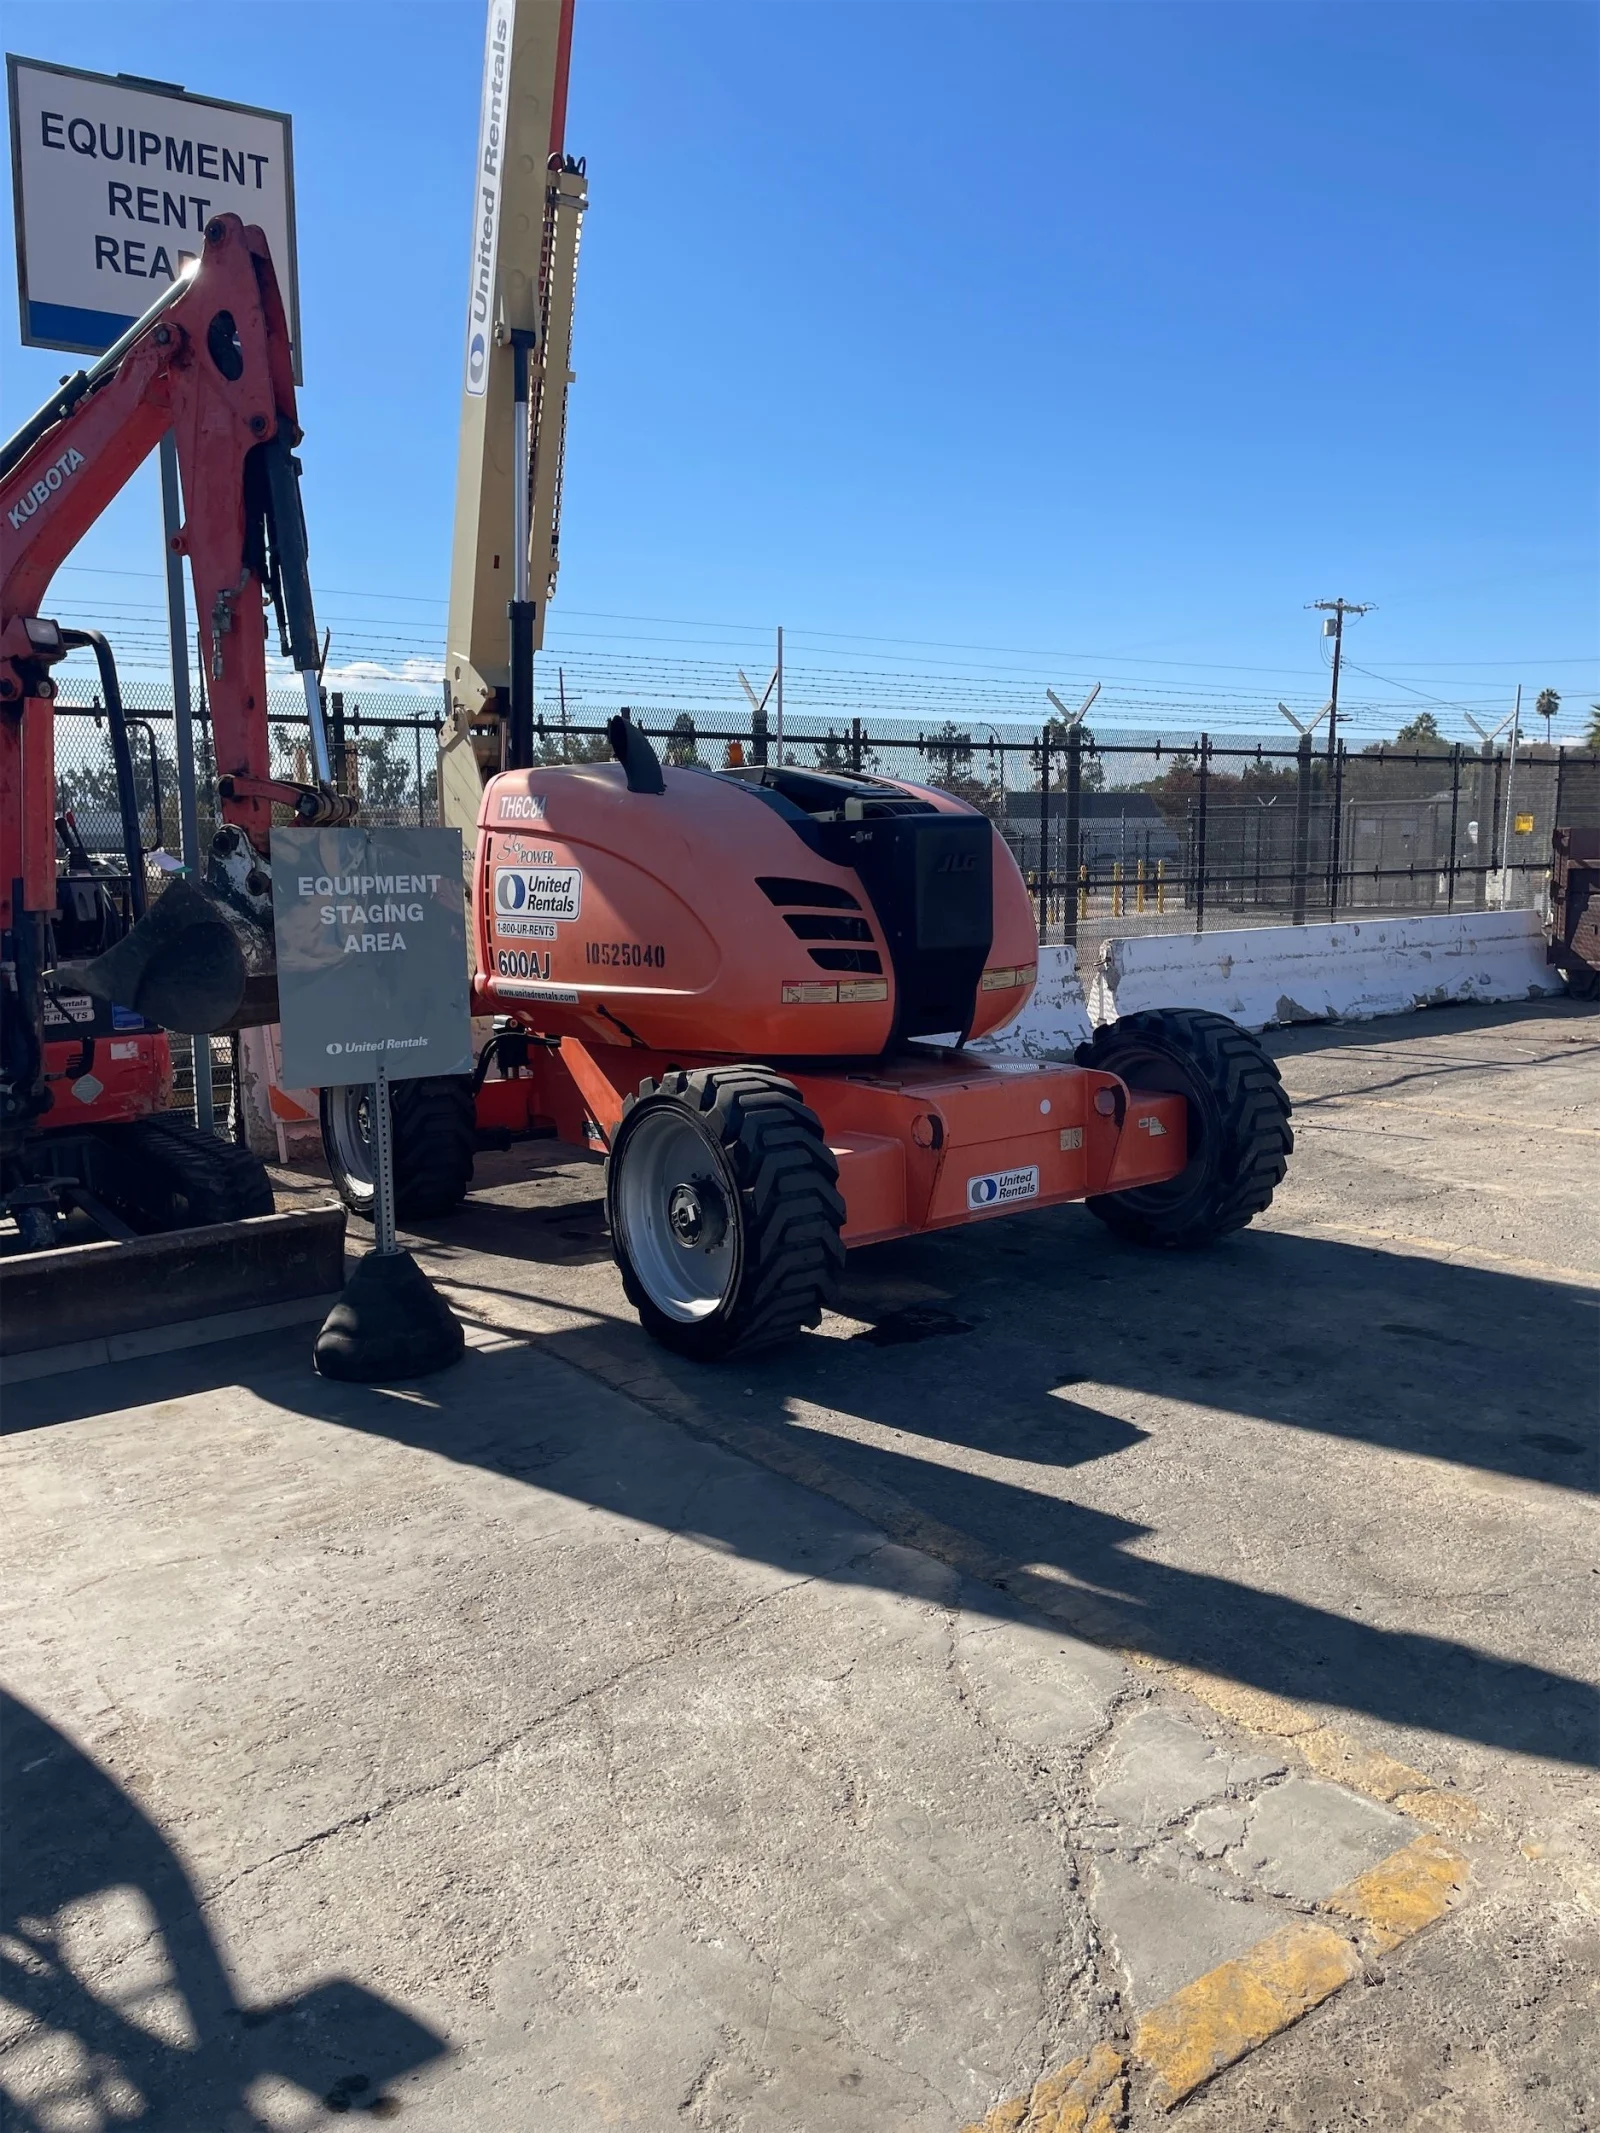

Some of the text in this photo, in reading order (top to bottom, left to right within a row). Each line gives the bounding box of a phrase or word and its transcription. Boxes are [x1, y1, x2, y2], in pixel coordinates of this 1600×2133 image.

[41, 110, 269, 189] EQUIPMENT
[473, 18, 508, 324] United Rentals
[107, 181, 211, 232] RENT
[7, 447, 85, 530] KUBOTA
[500, 795, 547, 819] TH6C84
[520, 850, 553, 863] POWER
[937, 852, 979, 873] JLG
[297, 874, 441, 896] EQUIPMENT
[528, 874, 571, 893] United
[527, 894, 575, 912] Rentals
[320, 903, 424, 925] STAGING
[497, 921, 555, 937] 1-800-UR-RENTS
[343, 932, 407, 953] AREA
[498, 950, 550, 979] 600AJ
[498, 988, 577, 1002] www.unitedrentals.com
[345, 1036, 429, 1054] United Rentals
[1000, 1171, 1033, 1187] United
[999, 1183, 1036, 1199] Rentals
